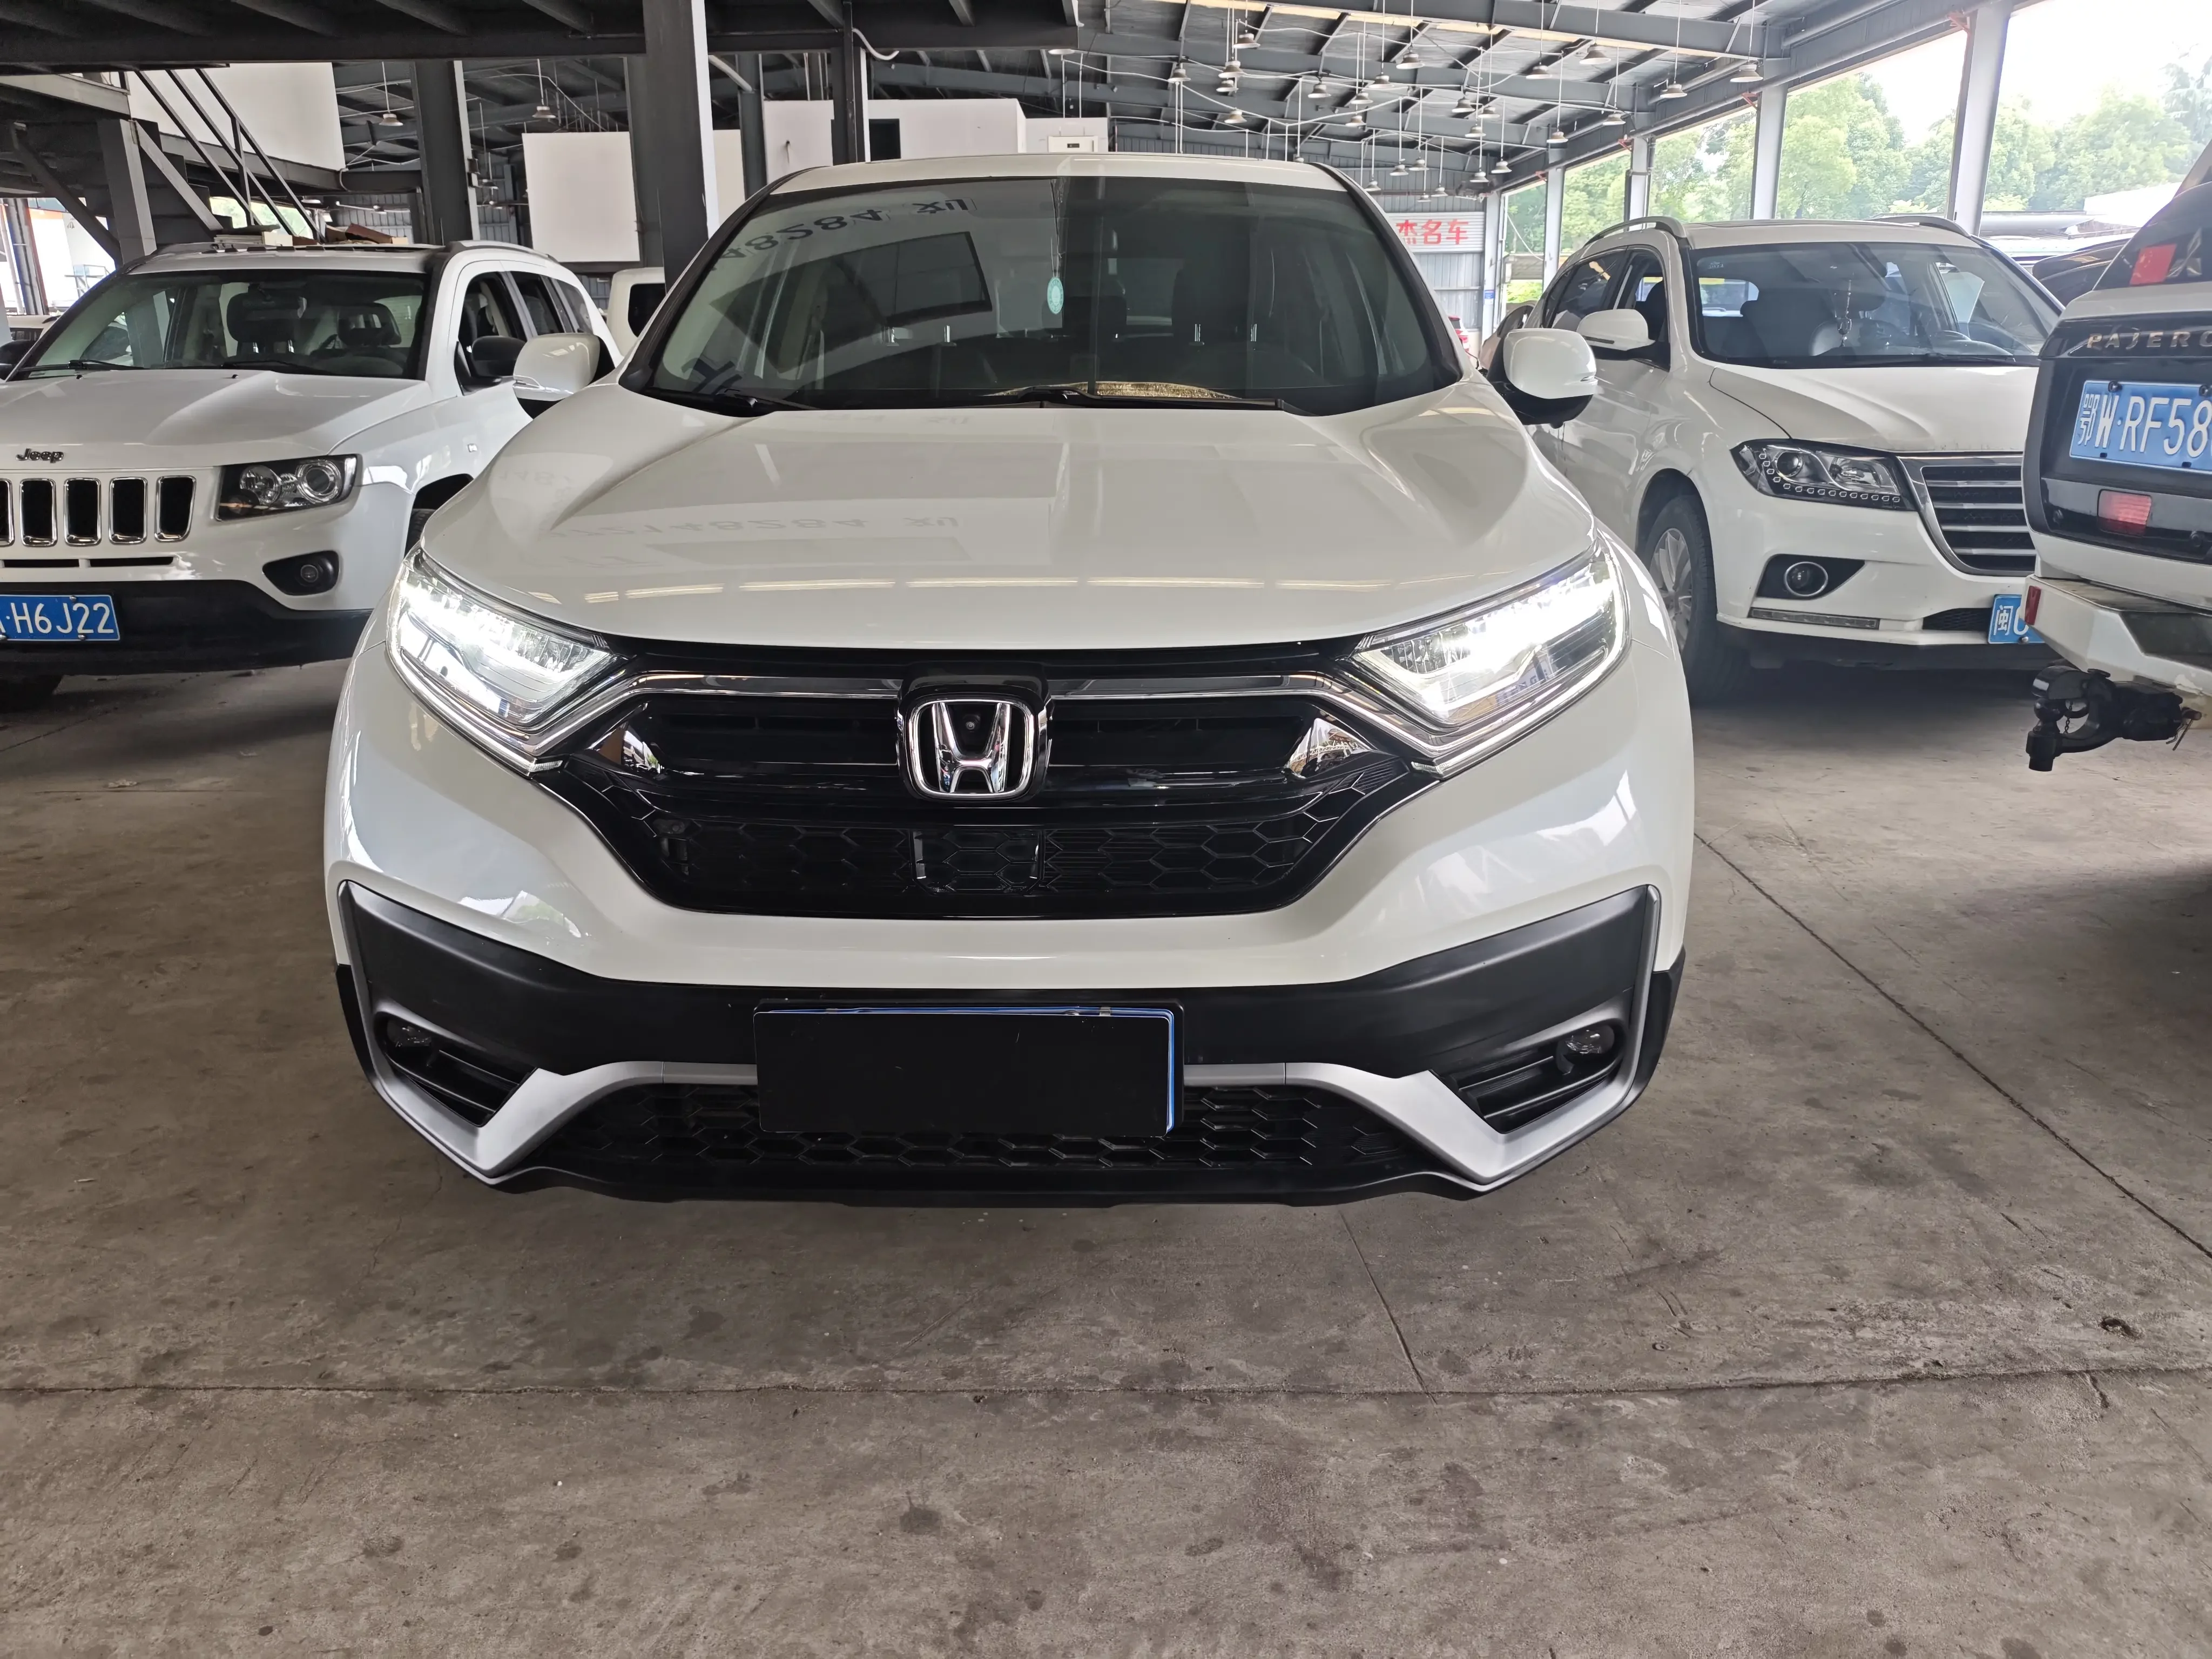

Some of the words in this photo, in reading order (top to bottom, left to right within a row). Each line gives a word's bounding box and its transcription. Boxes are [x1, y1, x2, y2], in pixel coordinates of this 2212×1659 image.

[1395, 219, 1469, 245] 杰名车
[2078, 394, 2212, 458] 鄂W·RF58
[16, 448, 64, 463] Jeep
[0, 603, 114, 634] ·H6J22
